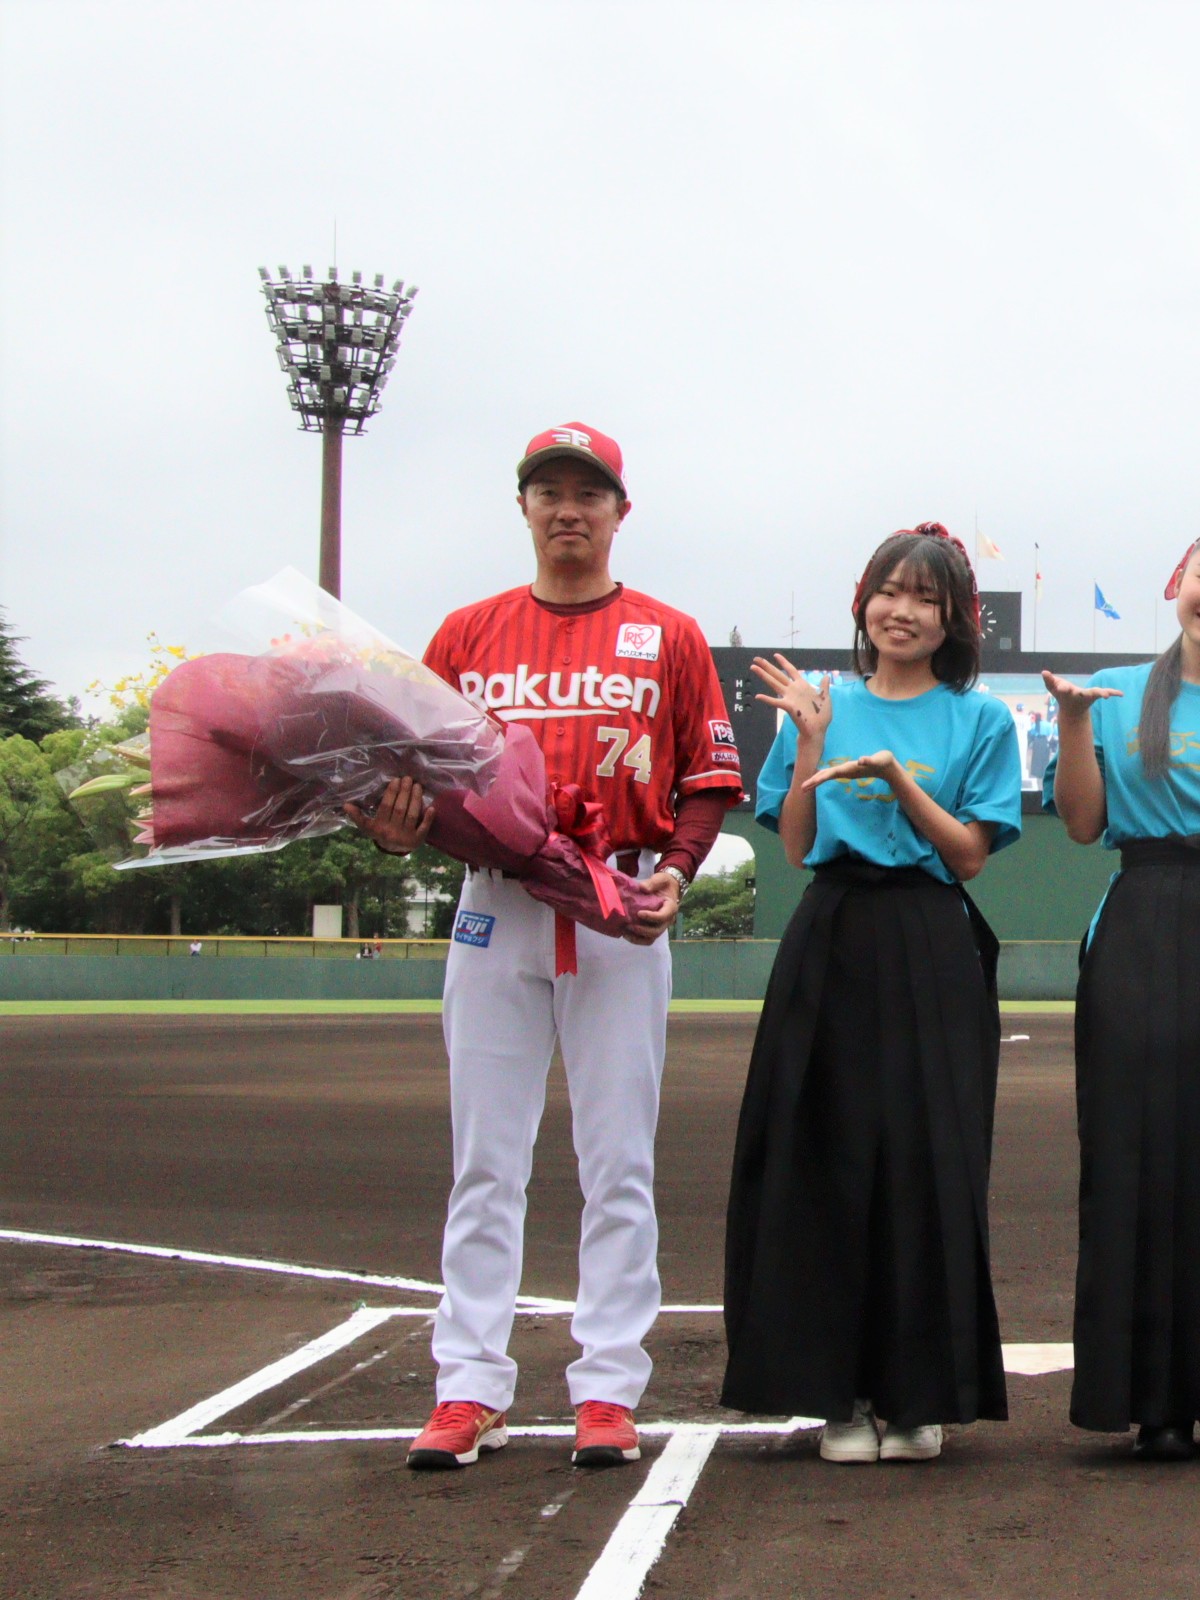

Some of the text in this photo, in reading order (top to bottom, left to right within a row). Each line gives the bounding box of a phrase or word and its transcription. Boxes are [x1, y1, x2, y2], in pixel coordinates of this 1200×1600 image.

[459, 664, 661, 718] Rakuten
[735, 680, 743, 688] H
[735, 692, 742, 700] E
[596, 726, 652, 784] 74
